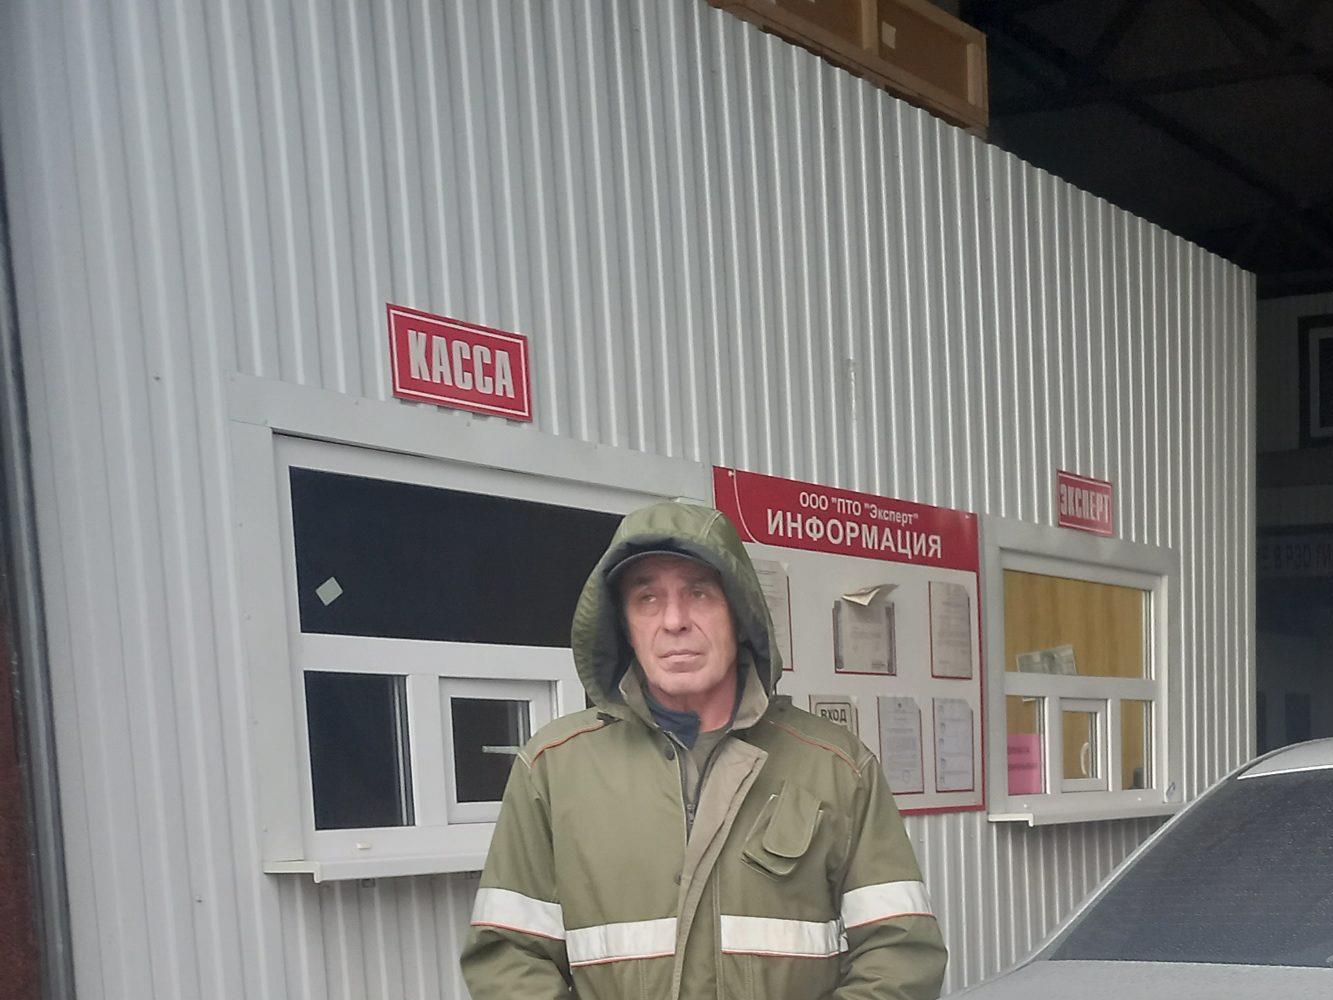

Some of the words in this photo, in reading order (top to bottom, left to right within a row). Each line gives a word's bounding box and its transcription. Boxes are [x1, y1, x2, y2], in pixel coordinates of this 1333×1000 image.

[408, 329, 515, 398] КАССА
[799, 491, 829, 511] ООО
[1060, 483, 1109, 524] ЭКСПЕРТ
[767, 508, 942, 559] ИНФОРМАЦИЯ
